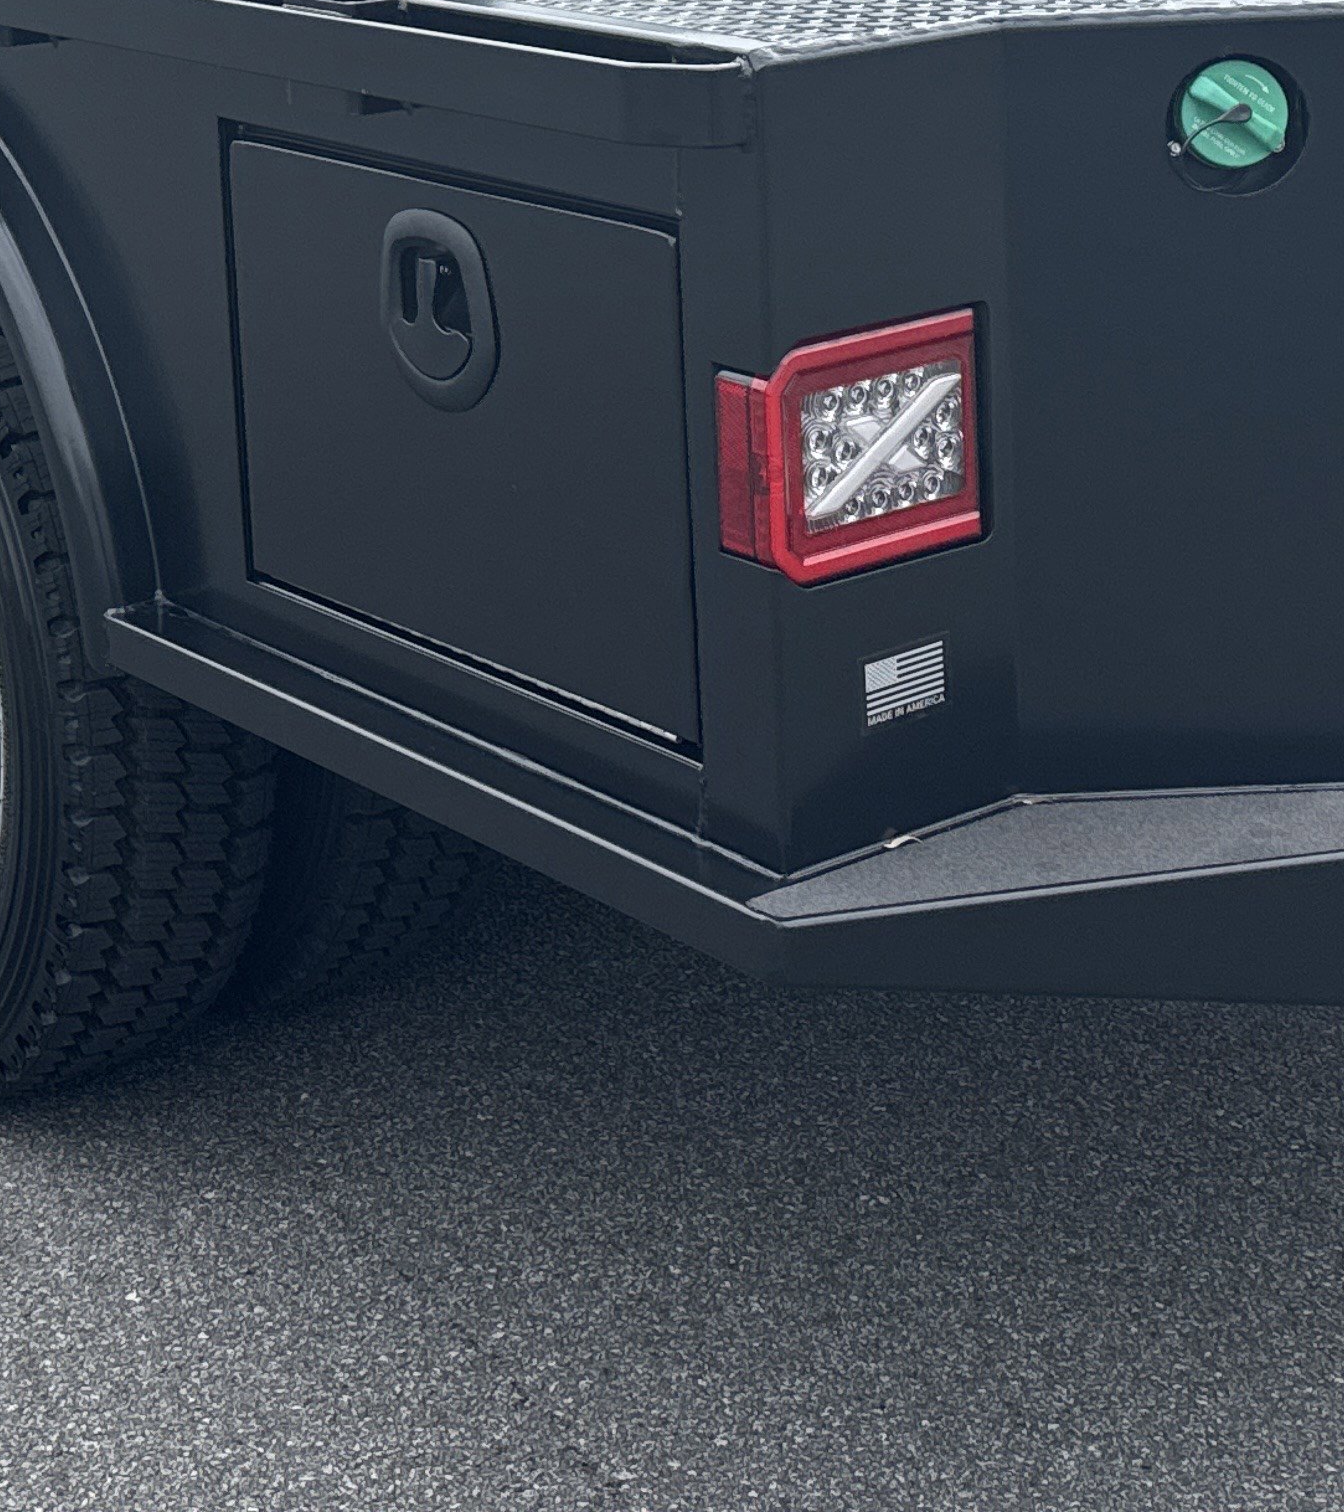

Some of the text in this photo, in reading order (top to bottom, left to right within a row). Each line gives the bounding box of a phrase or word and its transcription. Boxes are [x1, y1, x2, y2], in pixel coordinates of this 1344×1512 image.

[867, 693, 946, 727] MADE IN AMERICA
